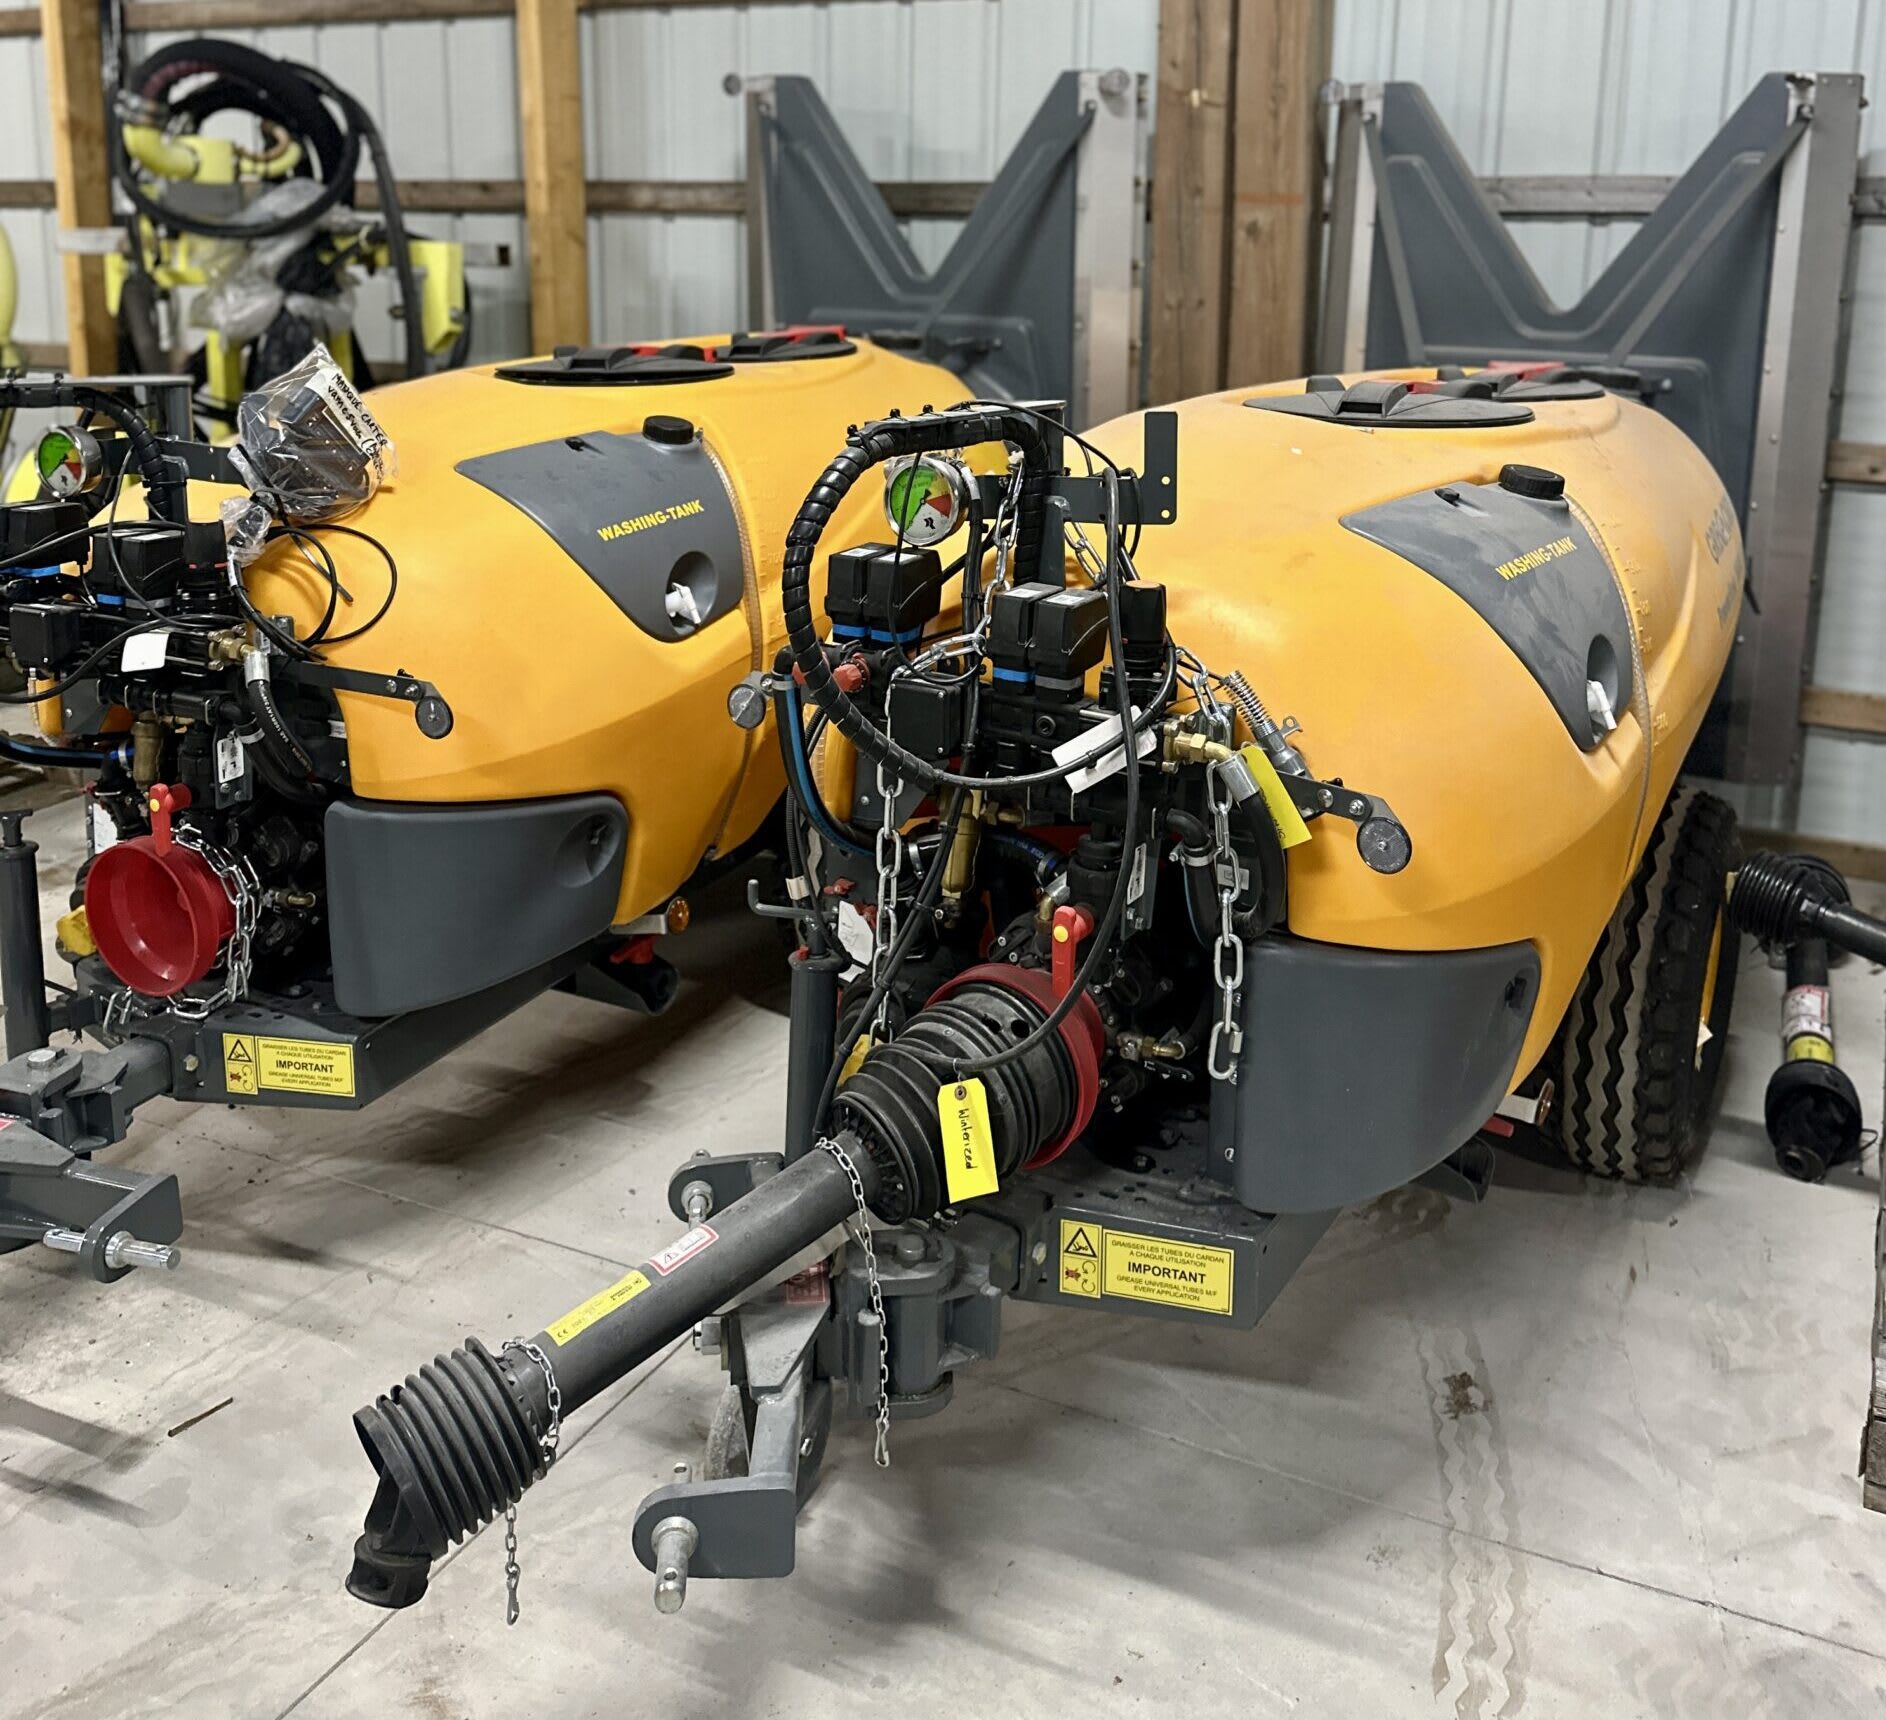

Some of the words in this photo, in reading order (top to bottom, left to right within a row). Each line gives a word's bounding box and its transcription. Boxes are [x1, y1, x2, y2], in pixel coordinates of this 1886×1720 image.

[597, 500, 704, 541] WASHING-TANK
[1495, 536, 1577, 580] WASHING-TANK
[276, 1060, 335, 1073] IMPORTANT
[1112, 1239, 1146, 1251] GRAISSER
[1161, 1247, 1183, 1257] TUBES
[1196, 1252, 1225, 1264] CARDAN
[1136, 1251, 1165, 1262] CHAQUE
[1166, 1256, 1207, 1268] UTILISATION
[1128, 1261, 1207, 1284] IMPORTANT
[1117, 1275, 1143, 1285] GREASE
[1145, 1279, 1181, 1291] UNIVERSAL
[1182, 1284, 1204, 1295] TUBES
[1134, 1285, 1155, 1295] EVERY
[1156, 1288, 1201, 1302] APPLICATION
